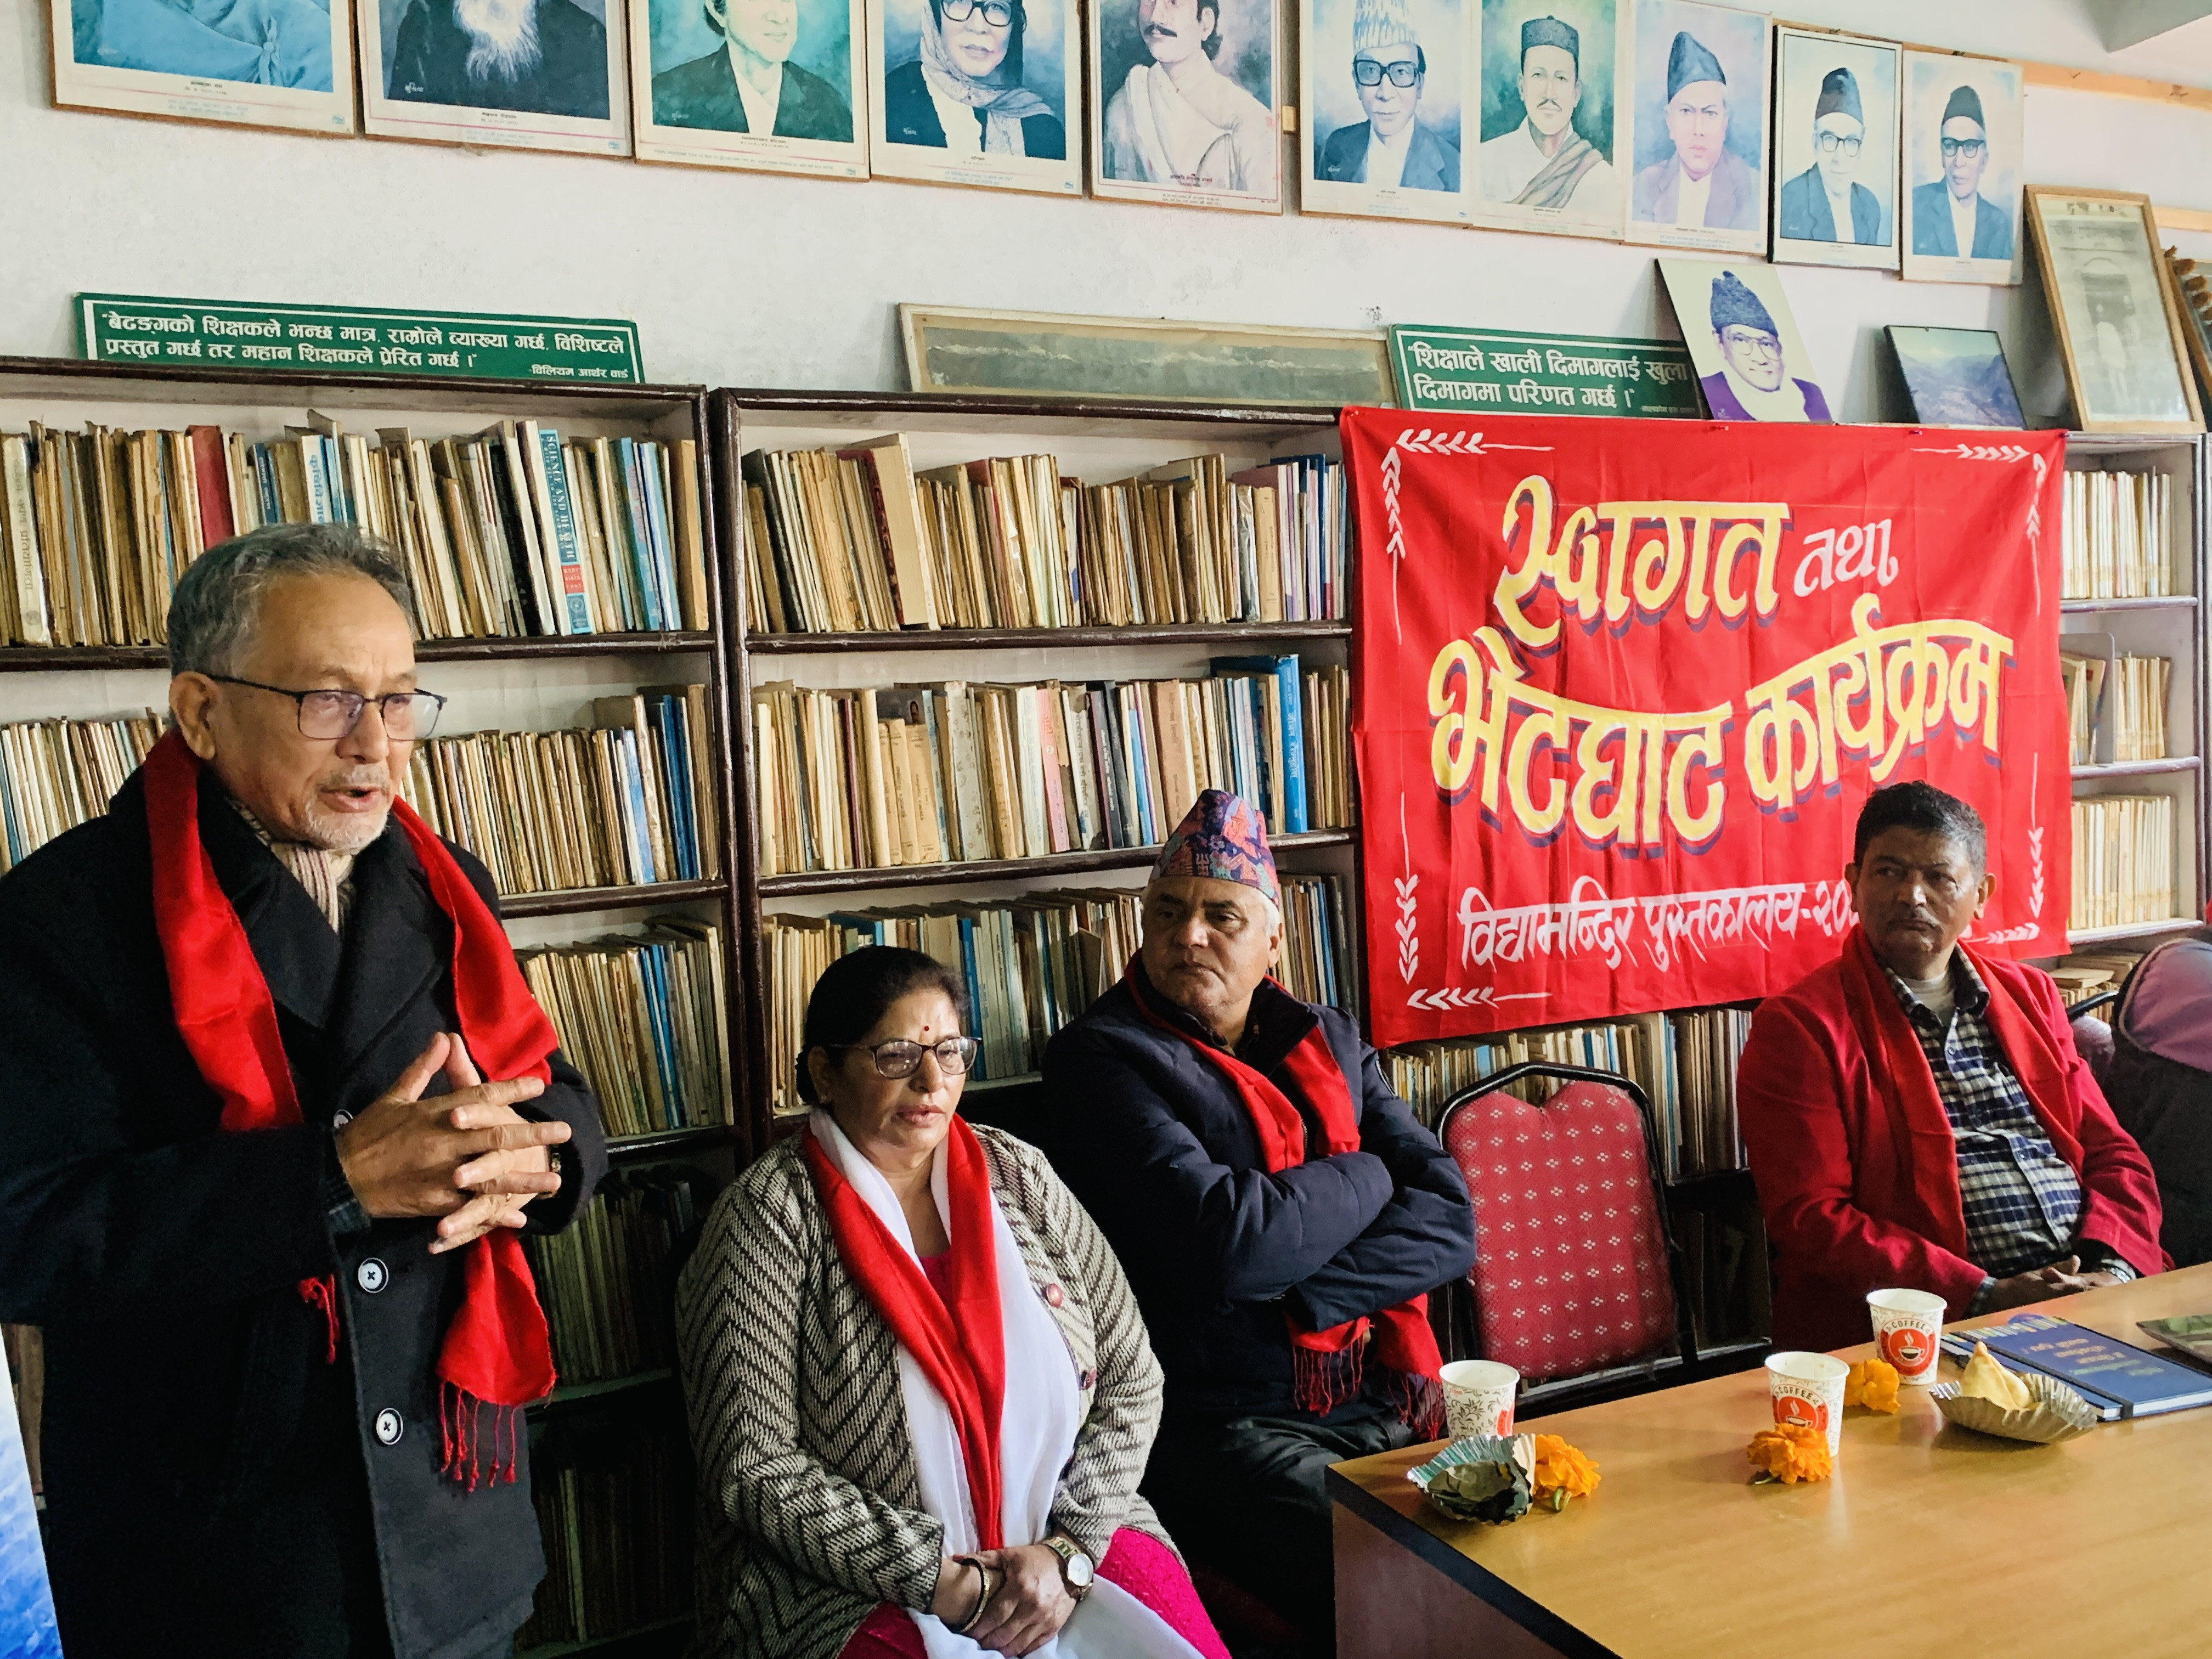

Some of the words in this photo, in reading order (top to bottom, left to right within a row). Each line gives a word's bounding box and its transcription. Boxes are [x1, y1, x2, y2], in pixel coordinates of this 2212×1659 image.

[105, 339, 160, 359] प्रस्तुत
[166, 339, 202, 357] गर्छ
[208, 344, 236, 359] तर
[241, 345, 292, 360] महान
[298, 343, 374, 364] शिक्षकले
[379, 346, 422, 365] प्रेरित
[428, 351, 460, 368] गर्छ
[202, 315, 281, 337] शिक्षकले
[289, 324, 334, 341] भन्छ
[387, 326, 443, 345] राम्रोले
[449, 332, 507, 348] व्याख्या
[554, 332, 624, 354] विशिष्टले
[1490, 348, 1543, 374] खाली
[1547, 349, 1640, 381] दिमागलाई
[1644, 361, 1688, 385] खुला
[1413, 373, 1502, 402] दिमागमा
[1506, 378, 1576, 406] परिणत
[1580, 383, 1617, 409] गर्छ
[546, 435, 562, 484] SCIENCE
[555, 488, 567, 511] AND
[1493, 475, 1790, 647] स्वागत
[1793, 518, 1899, 597] तथा
[1427, 626, 1733, 844] भेटघाट
[1744, 592, 2014, 809] कार्यक्रम
[1456, 875, 1638, 973] विद्यामन्दिर
[1892, 1320, 1926, 1330] COFFEE
[1778, 1386, 1813, 1400] COFFEE
